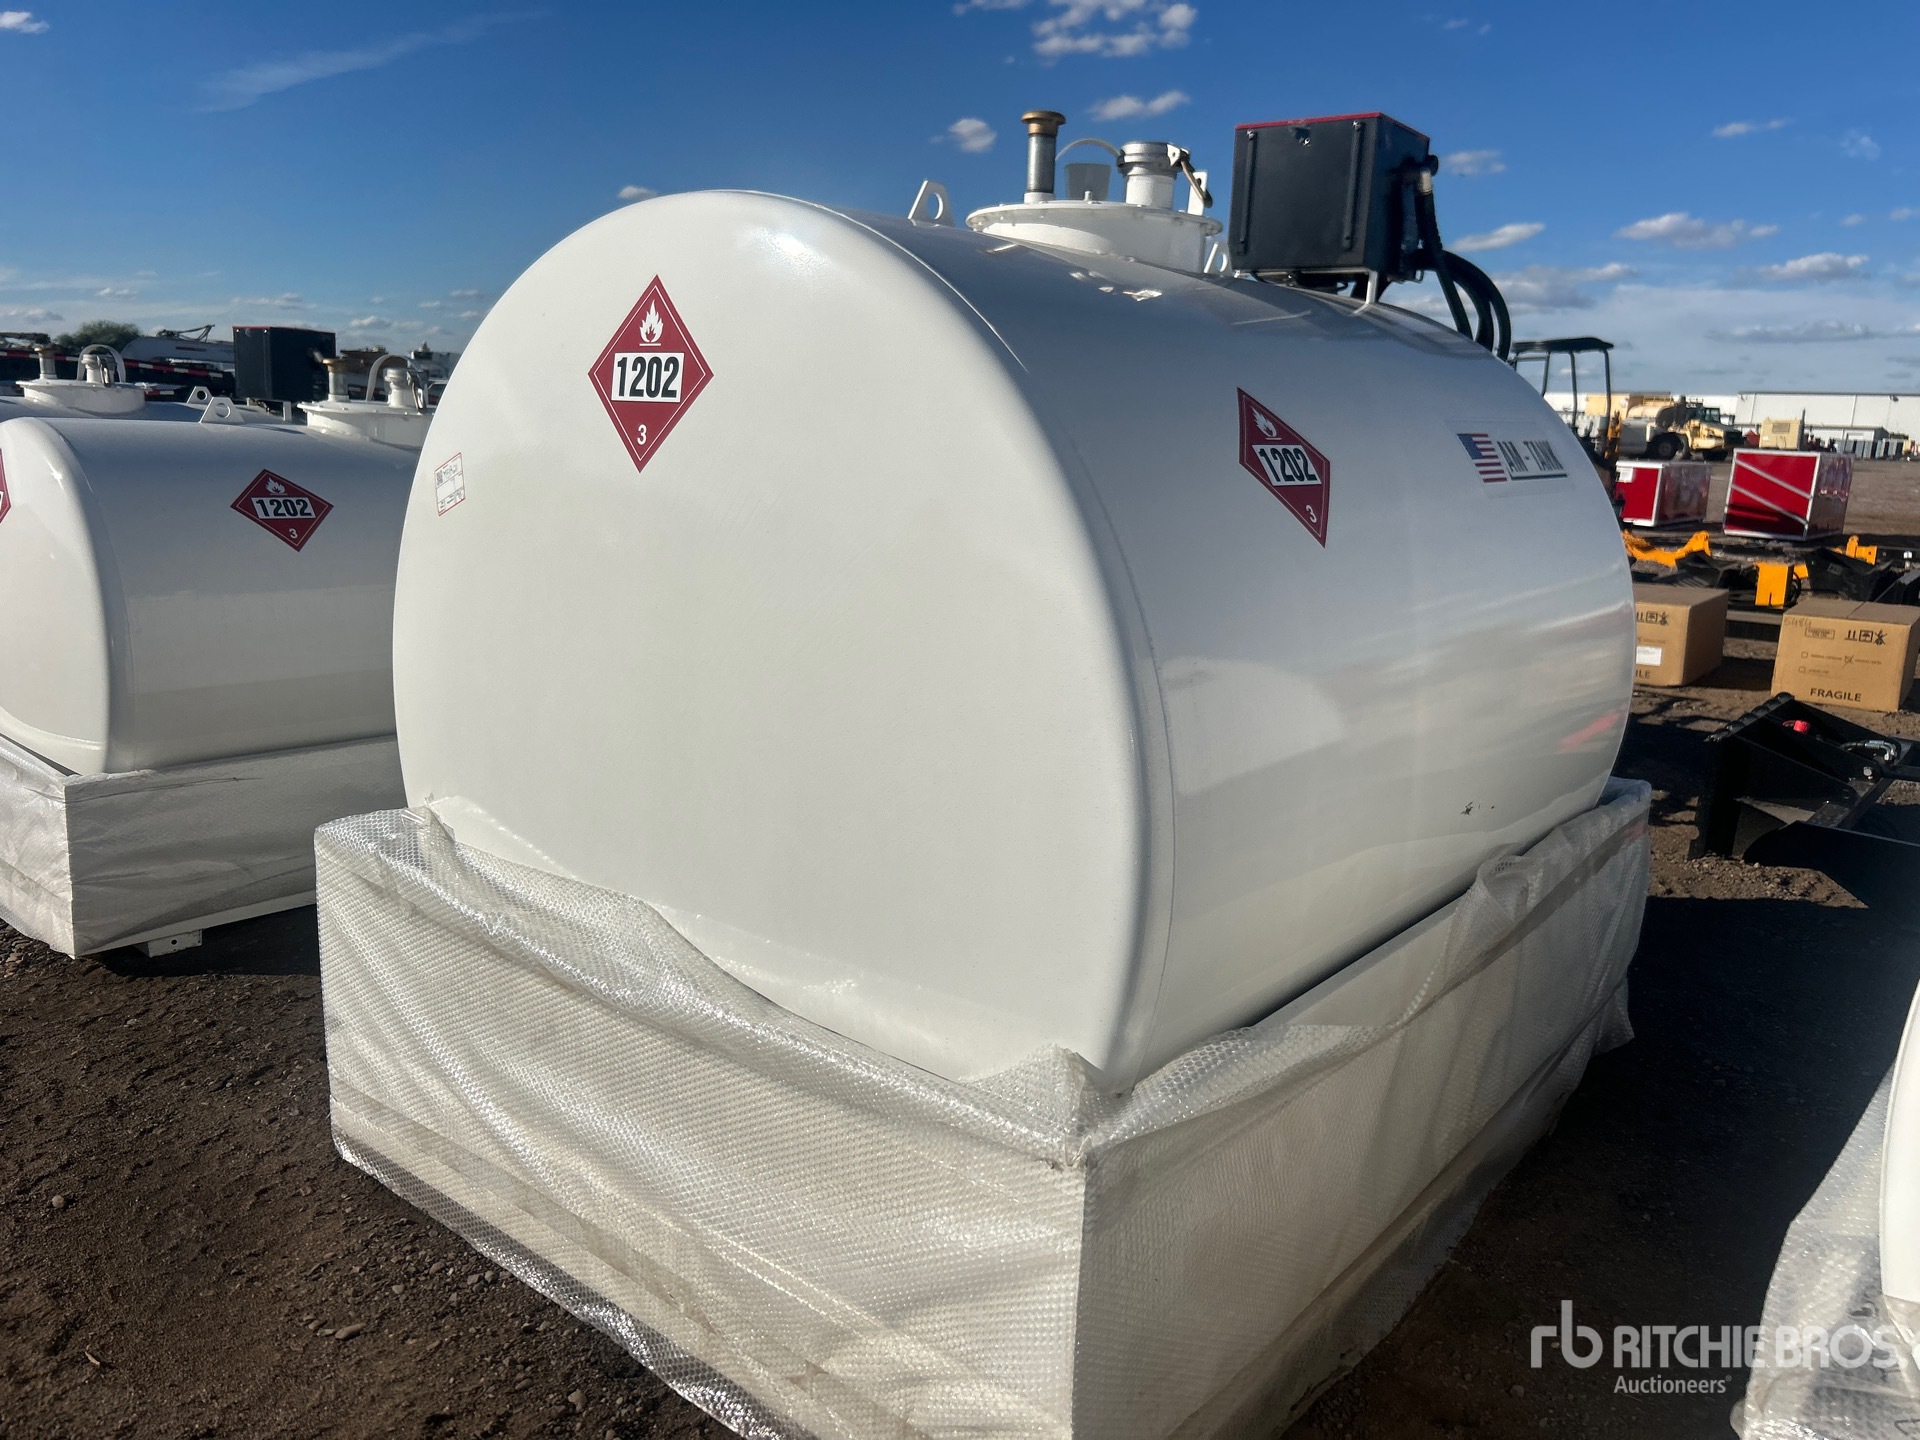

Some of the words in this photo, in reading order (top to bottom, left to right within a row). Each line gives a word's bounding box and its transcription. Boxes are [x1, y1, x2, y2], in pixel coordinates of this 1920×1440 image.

[616, 356, 680, 398] 1202
[636, 424, 647, 445] 3
[1258, 447, 1318, 483] 1202
[255, 498, 312, 517] 1202
[1305, 504, 1317, 524] 3
[288, 527, 299, 539] 3
[1809, 687, 1862, 702] FRAGILE
